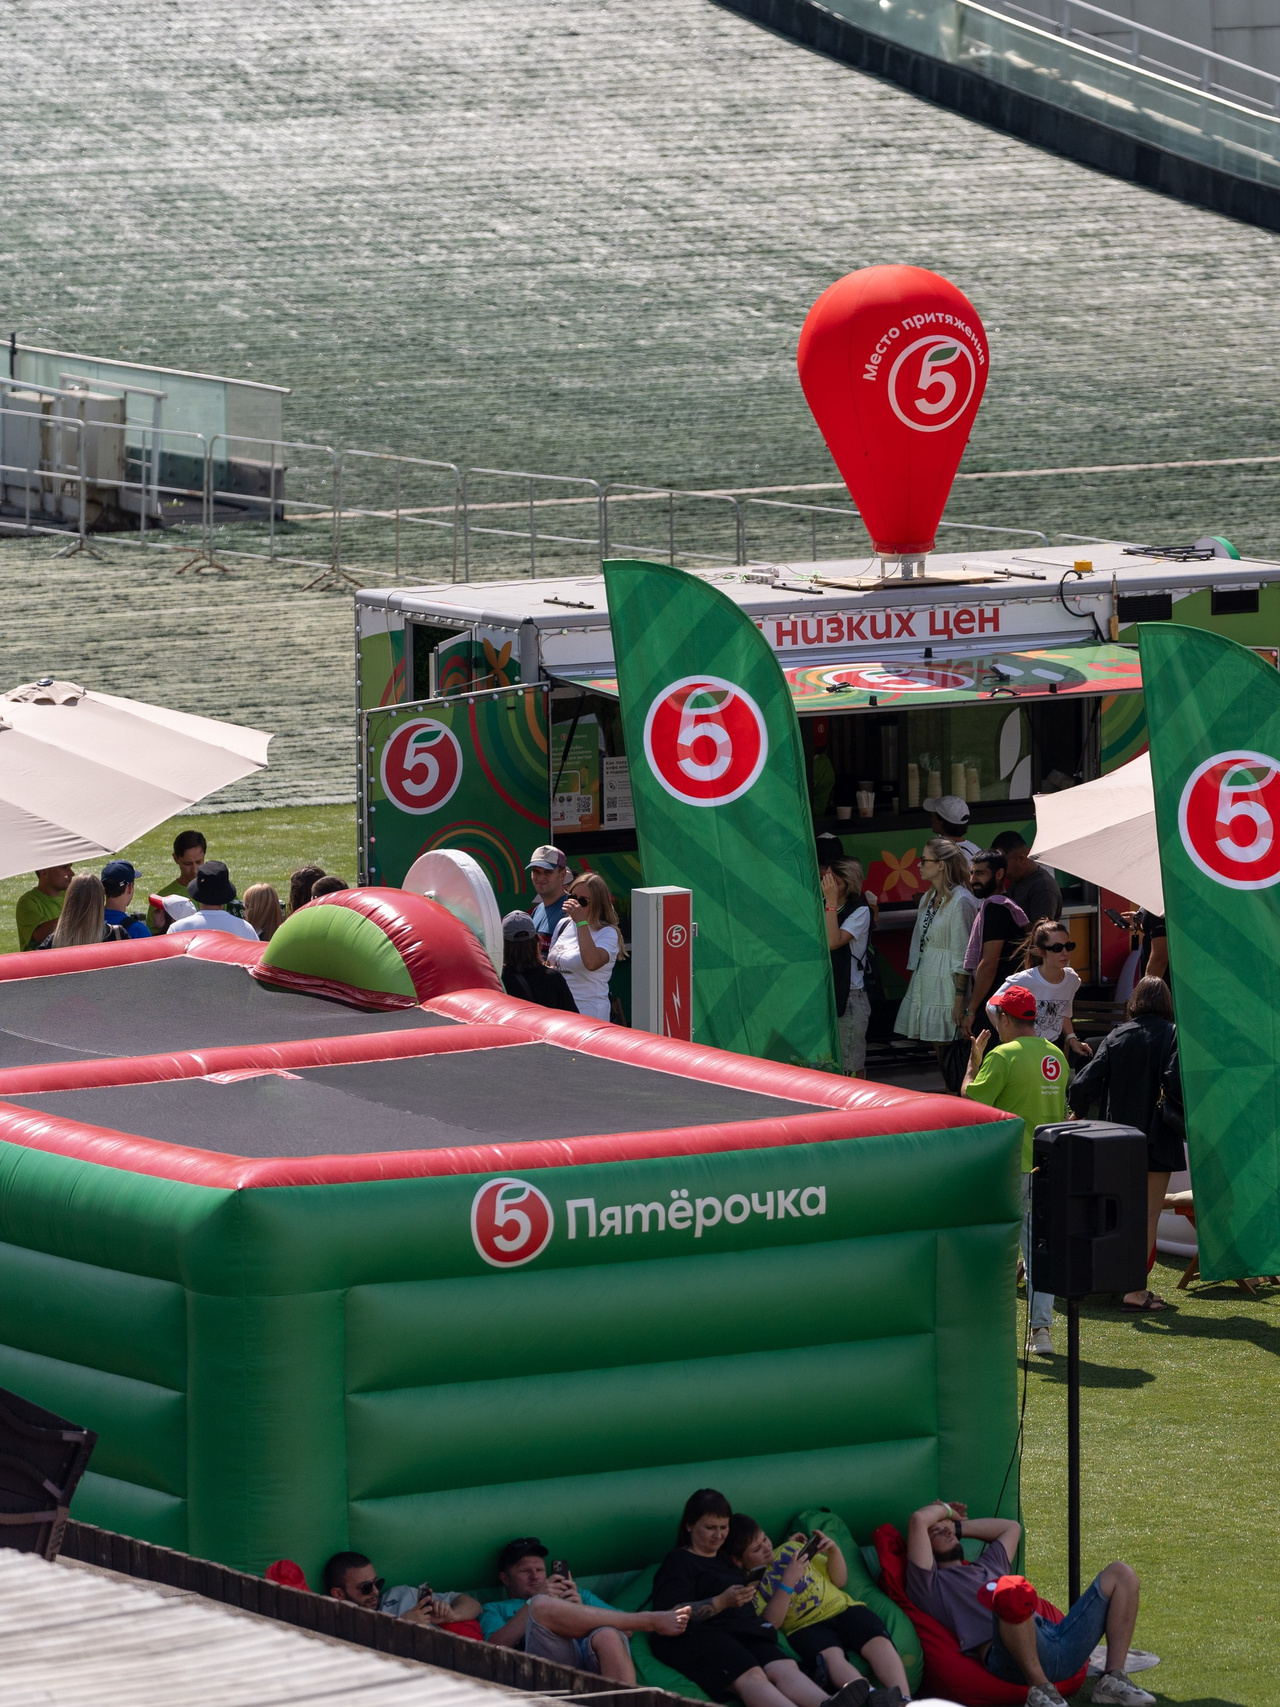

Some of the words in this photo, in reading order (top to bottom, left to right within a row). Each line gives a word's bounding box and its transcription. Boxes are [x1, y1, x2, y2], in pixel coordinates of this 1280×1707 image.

[863, 326, 900, 381] Место
[901, 312, 985, 366] притяжения
[914, 342, 962, 415] 5
[401, 727, 446, 796] 5
[677, 684, 735, 781] 5
[1215, 761, 1278, 863] 5
[493, 1183, 531, 1252] 5
[566, 1185, 826, 1239] Пятёрочка
